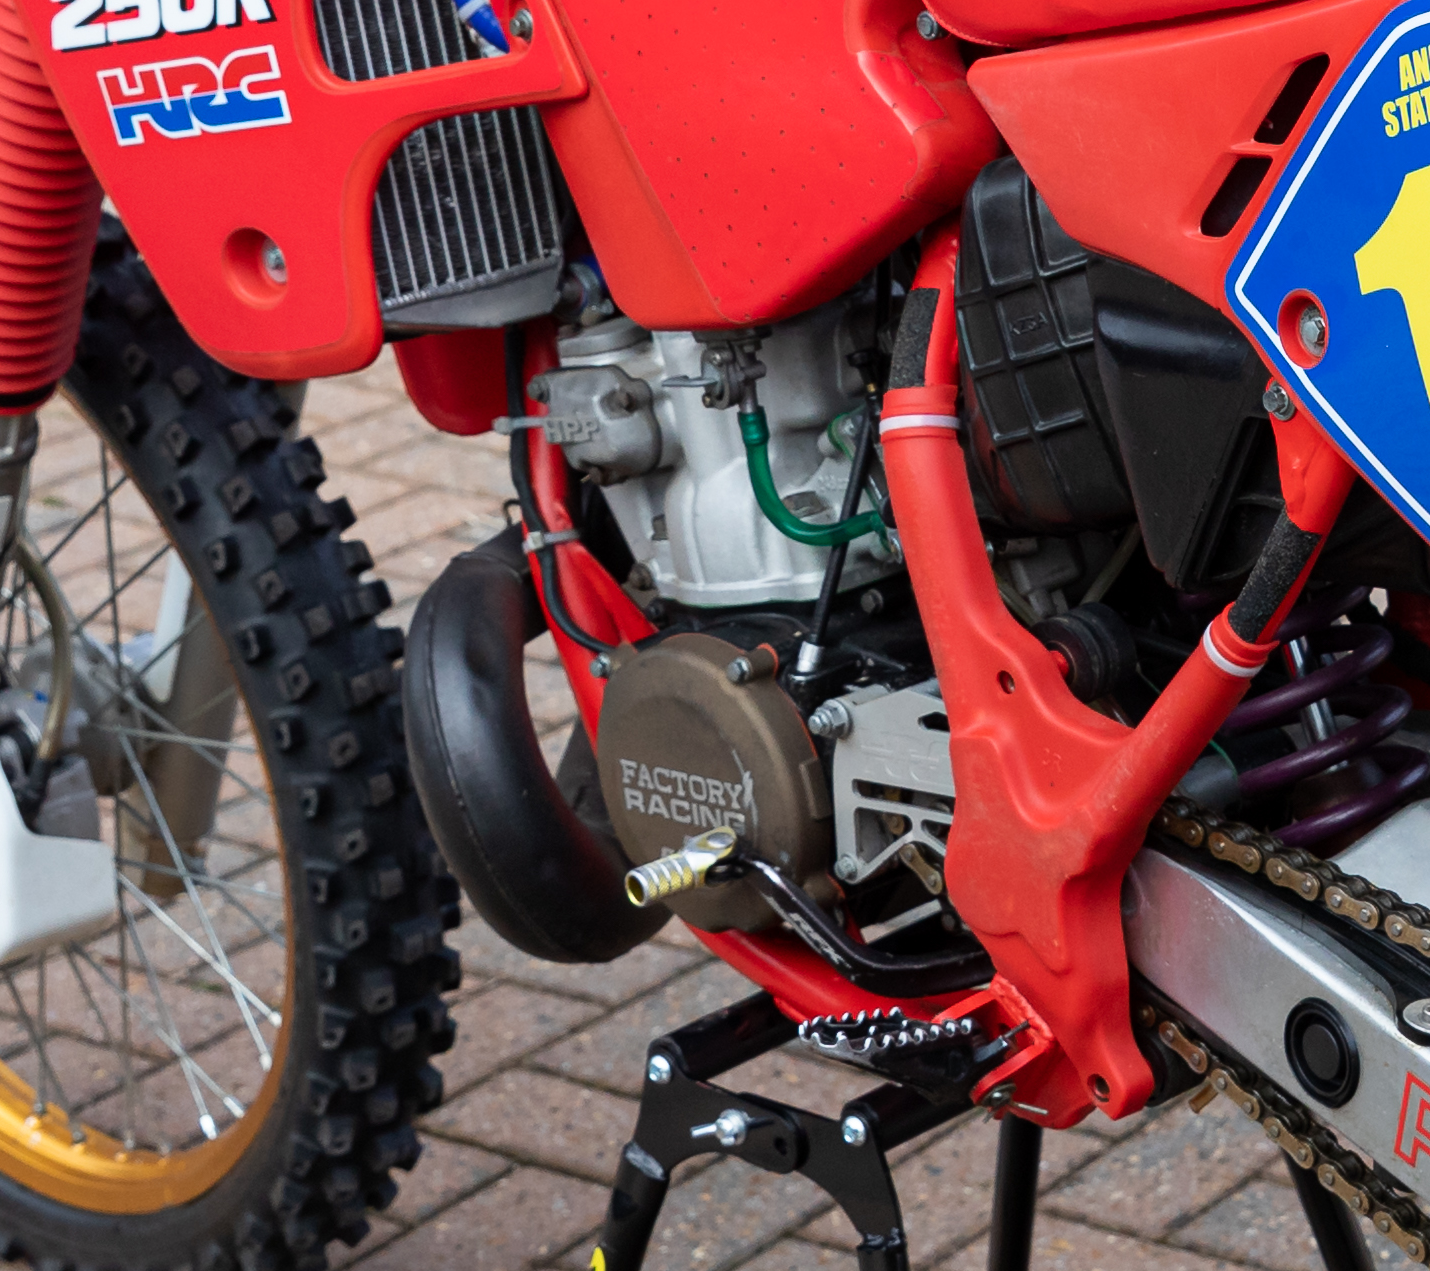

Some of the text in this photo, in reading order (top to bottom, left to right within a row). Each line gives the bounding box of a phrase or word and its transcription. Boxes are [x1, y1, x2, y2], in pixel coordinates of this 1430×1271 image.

[96, 44, 292, 148] HRC
[619, 759, 742, 810] FACTORY
[623, 787, 746, 836] RACING
